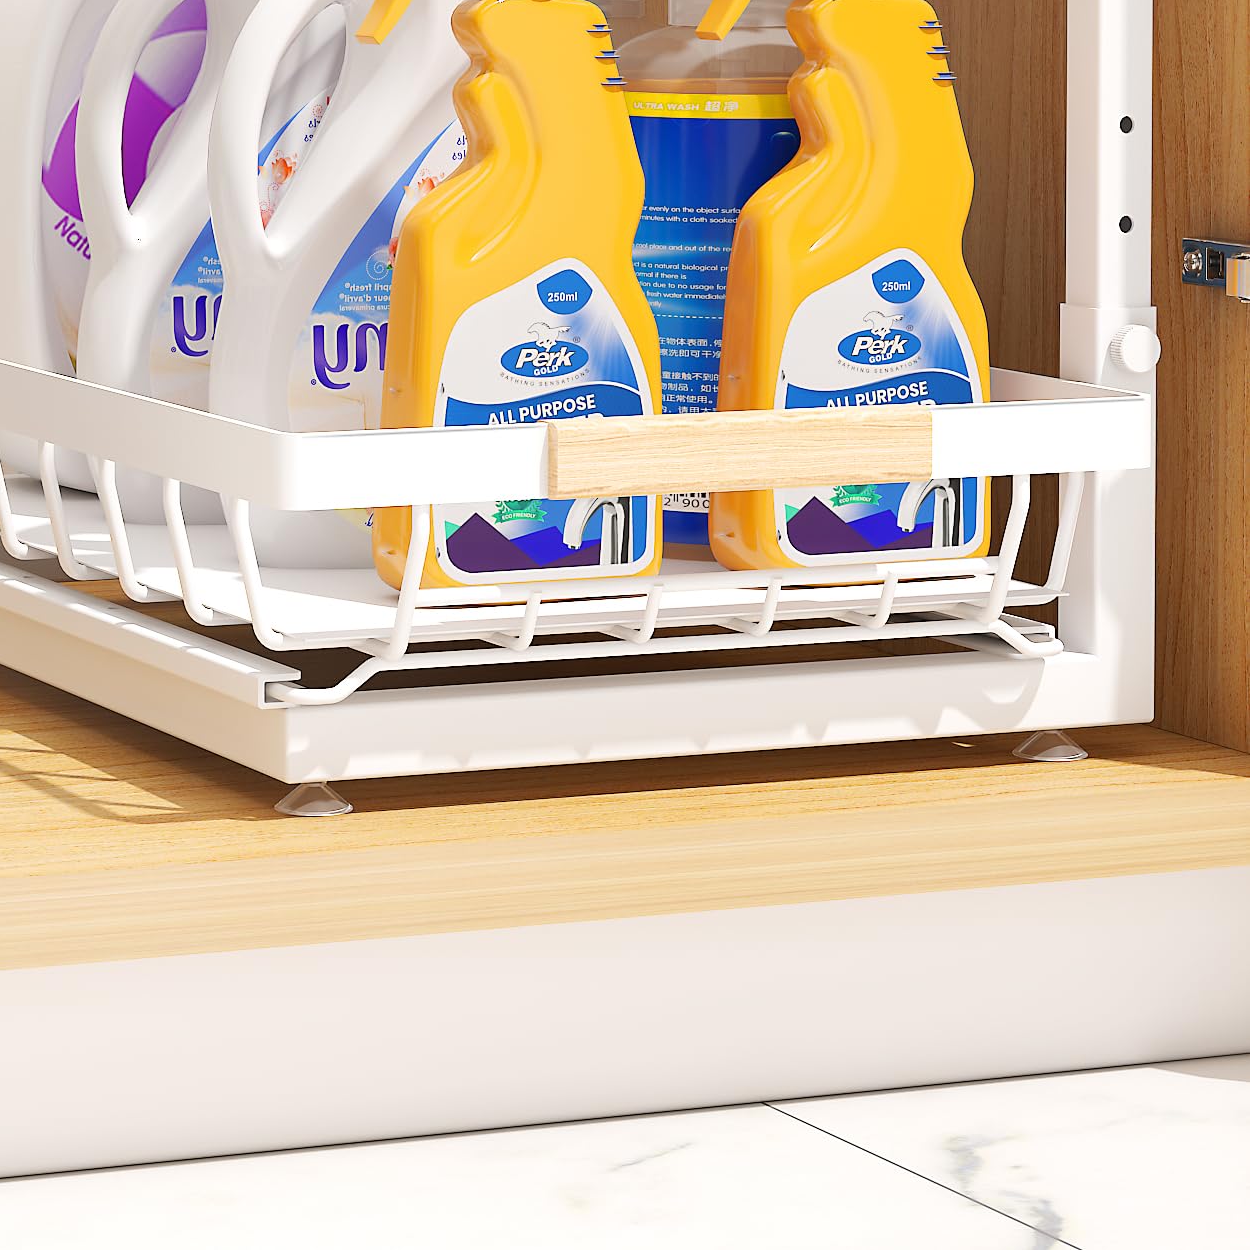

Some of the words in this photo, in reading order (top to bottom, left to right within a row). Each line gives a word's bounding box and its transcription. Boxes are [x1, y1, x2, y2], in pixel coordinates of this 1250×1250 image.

[633, 101, 664, 110] ULTRA
[667, 103, 700, 111] WASH
[696, 206, 719, 215] object
[681, 264, 718, 272] biological
[881, 281, 911, 292] 250ml
[547, 291, 578, 303] 250ml
[851, 334, 908, 356] Perk
[515, 347, 575, 369] Perk
[869, 352, 893, 363] GOLD
[533, 365, 558, 376] GOLD
[837, 359, 870, 374] BATHING
[874, 356, 921, 373] SENSATIONS
[500, 372, 535, 387] BATHING
[539, 368, 590, 387] SENSATIONS
[855, 381, 928, 406] PURPOSE
[487, 409, 517, 425] ALL
[518, 394, 597, 422] PURPOSE
